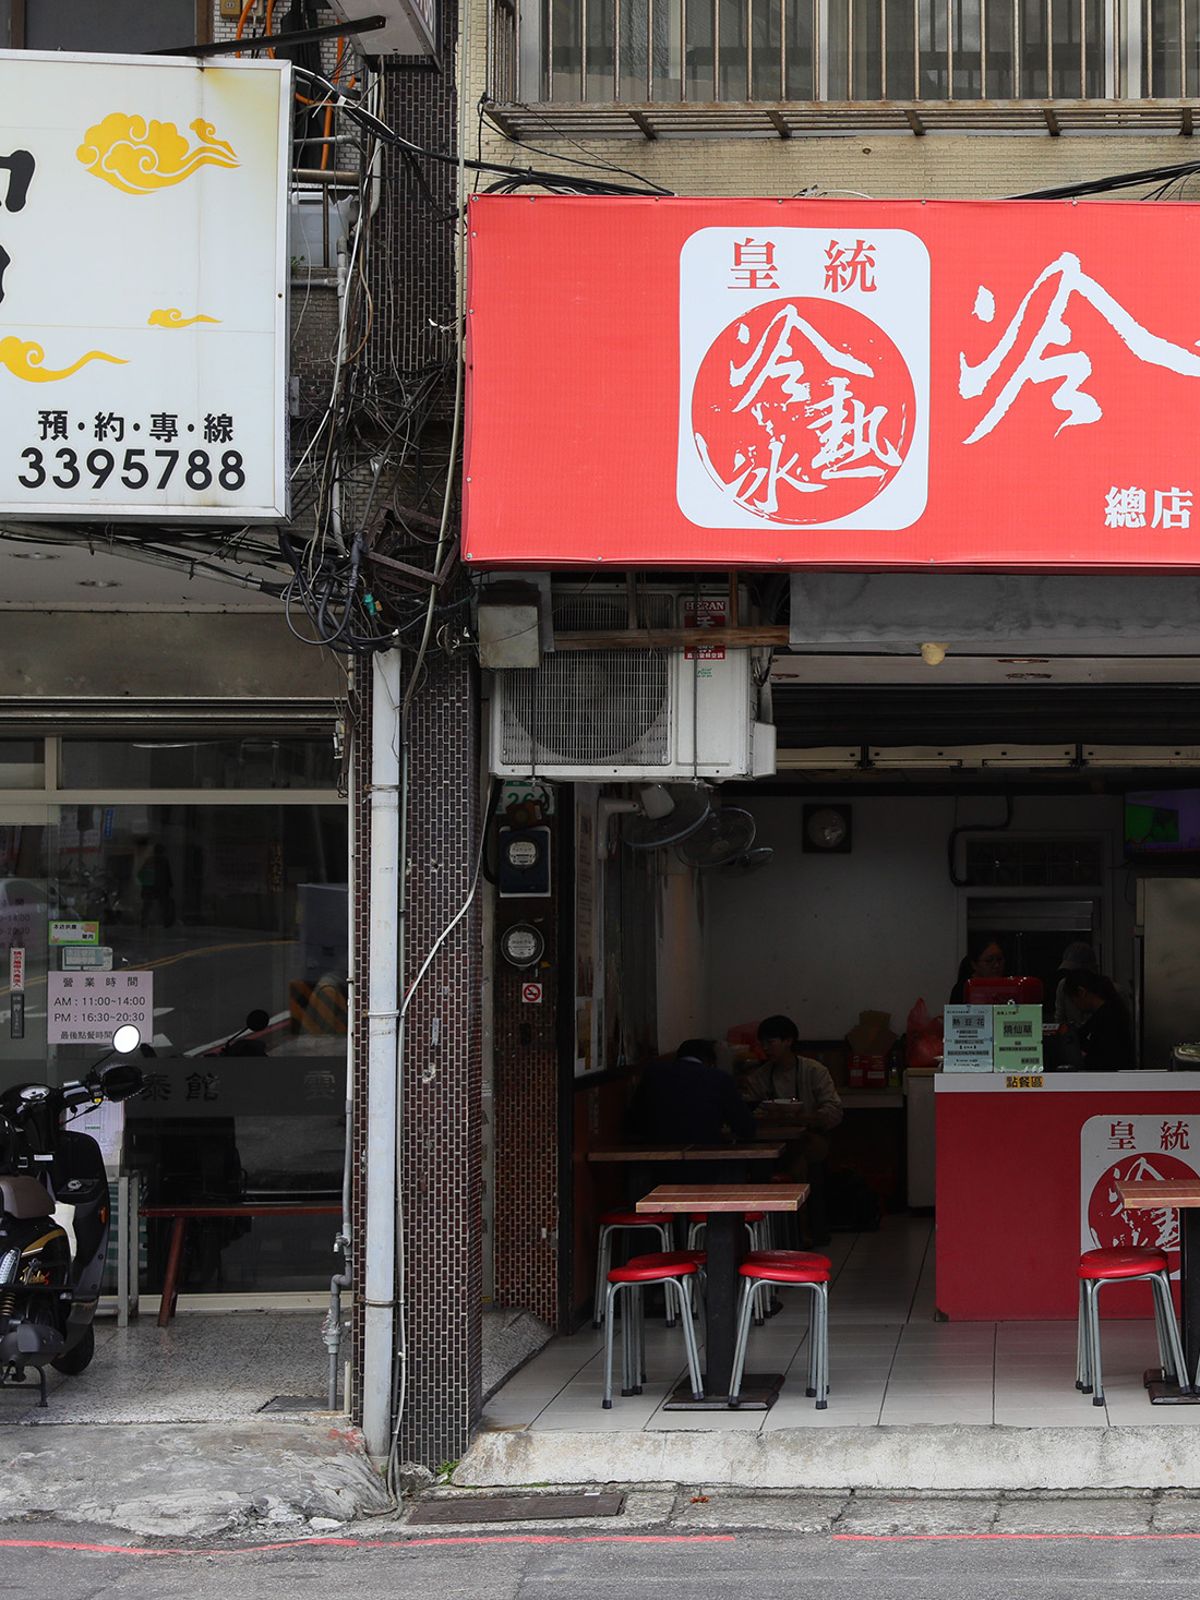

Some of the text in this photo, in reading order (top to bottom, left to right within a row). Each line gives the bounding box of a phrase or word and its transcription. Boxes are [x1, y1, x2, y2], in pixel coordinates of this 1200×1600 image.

[728, 238, 878, 293] 皇統
[18, 448, 246, 491] 3395788
[686, 601, 725, 611] HERAN
[63, 976, 139, 988] 營業時間
[1006, 1076, 1043, 1088] 點餐區
[1107, 1120, 1190, 1151] 皇統
